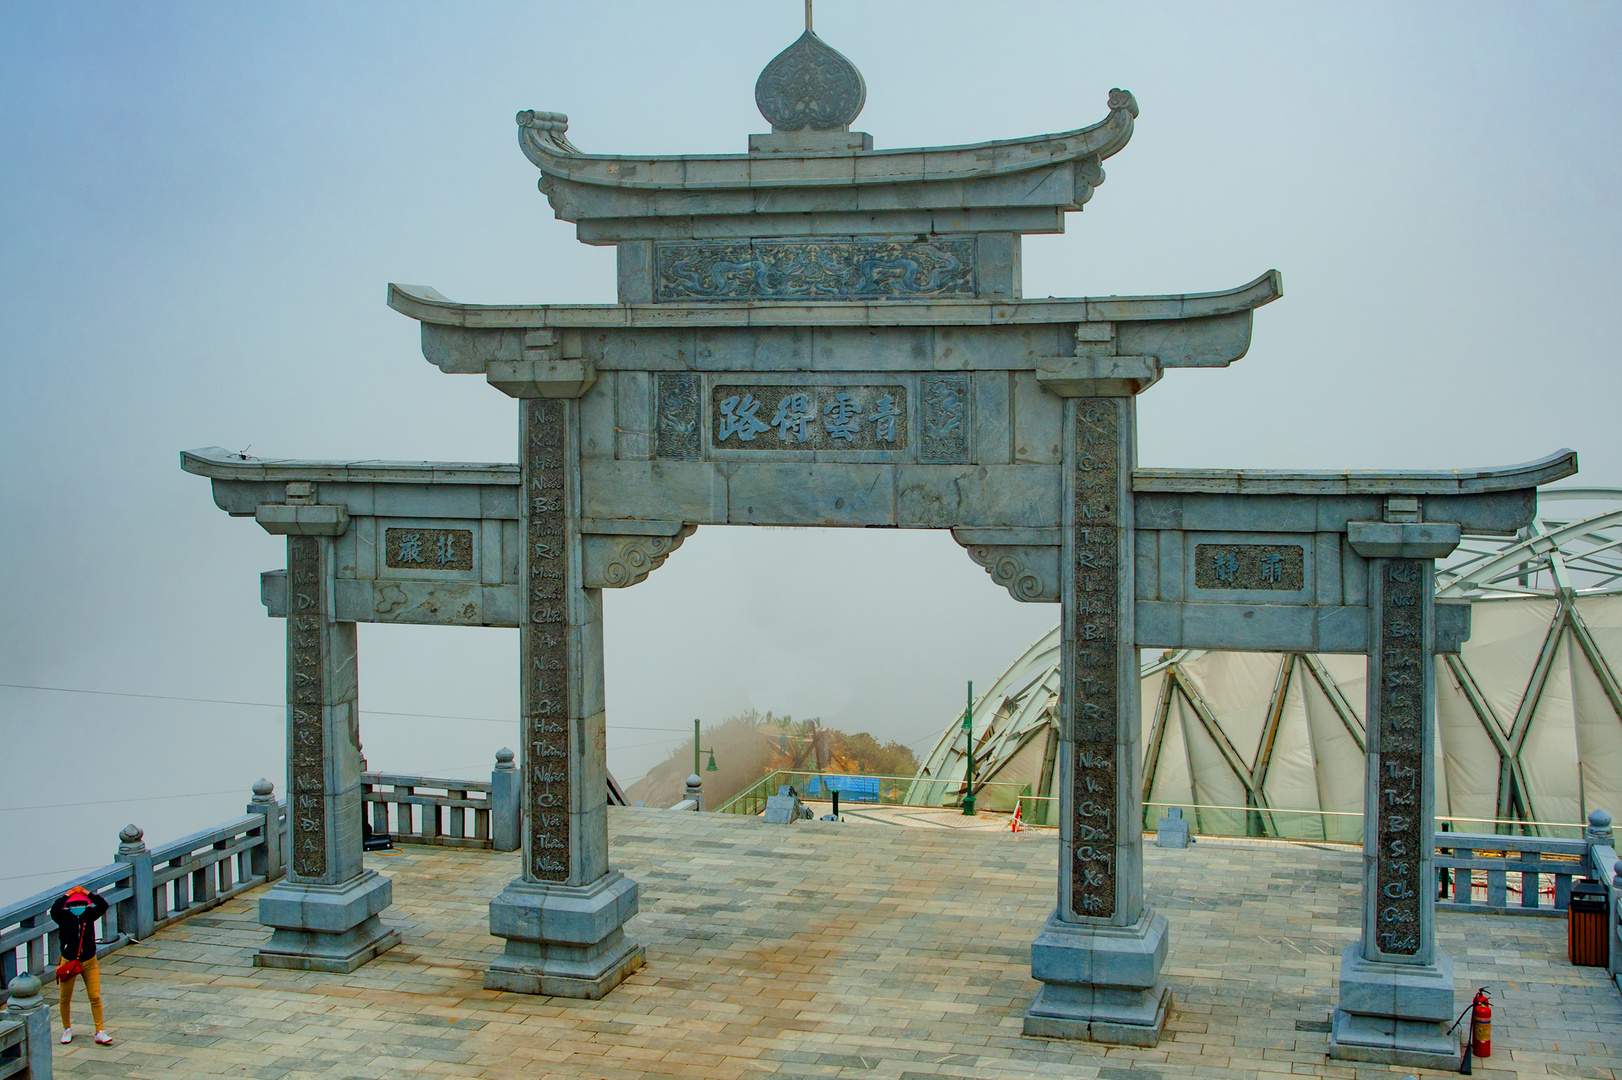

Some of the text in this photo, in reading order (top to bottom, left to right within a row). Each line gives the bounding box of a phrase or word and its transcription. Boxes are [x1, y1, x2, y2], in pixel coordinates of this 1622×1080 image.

[534, 409, 556, 423] Non
[531, 431, 561, 447] Xanh
[535, 455, 558, 470] Hòa
[533, 476, 562, 490] Nước
[1389, 564, 1418, 583] Khổ
[534, 585, 561, 600] Suối
[534, 718, 564, 733] Hoàn
[532, 739, 566, 758] Thành
[533, 763, 566, 795] Nghĩa
[541, 812, 560, 827] Với
[1079, 800, 1110, 831] Công
[1388, 815, 1411, 833] Bỏ
[301, 818, 320, 831] Để
[1079, 824, 1108, 841] Dân
[536, 832, 566, 849] Thân
[1390, 840, 1406, 857] Si
[536, 855, 565, 871] Nhân
[1077, 846, 1111, 875] Cùng
[1390, 860, 1409, 875] Mê
[1084, 869, 1103, 887] Xã
[1384, 879, 1414, 900] Cho
[1383, 907, 1415, 925] Giải
[1380, 930, 1416, 950] Thoát
